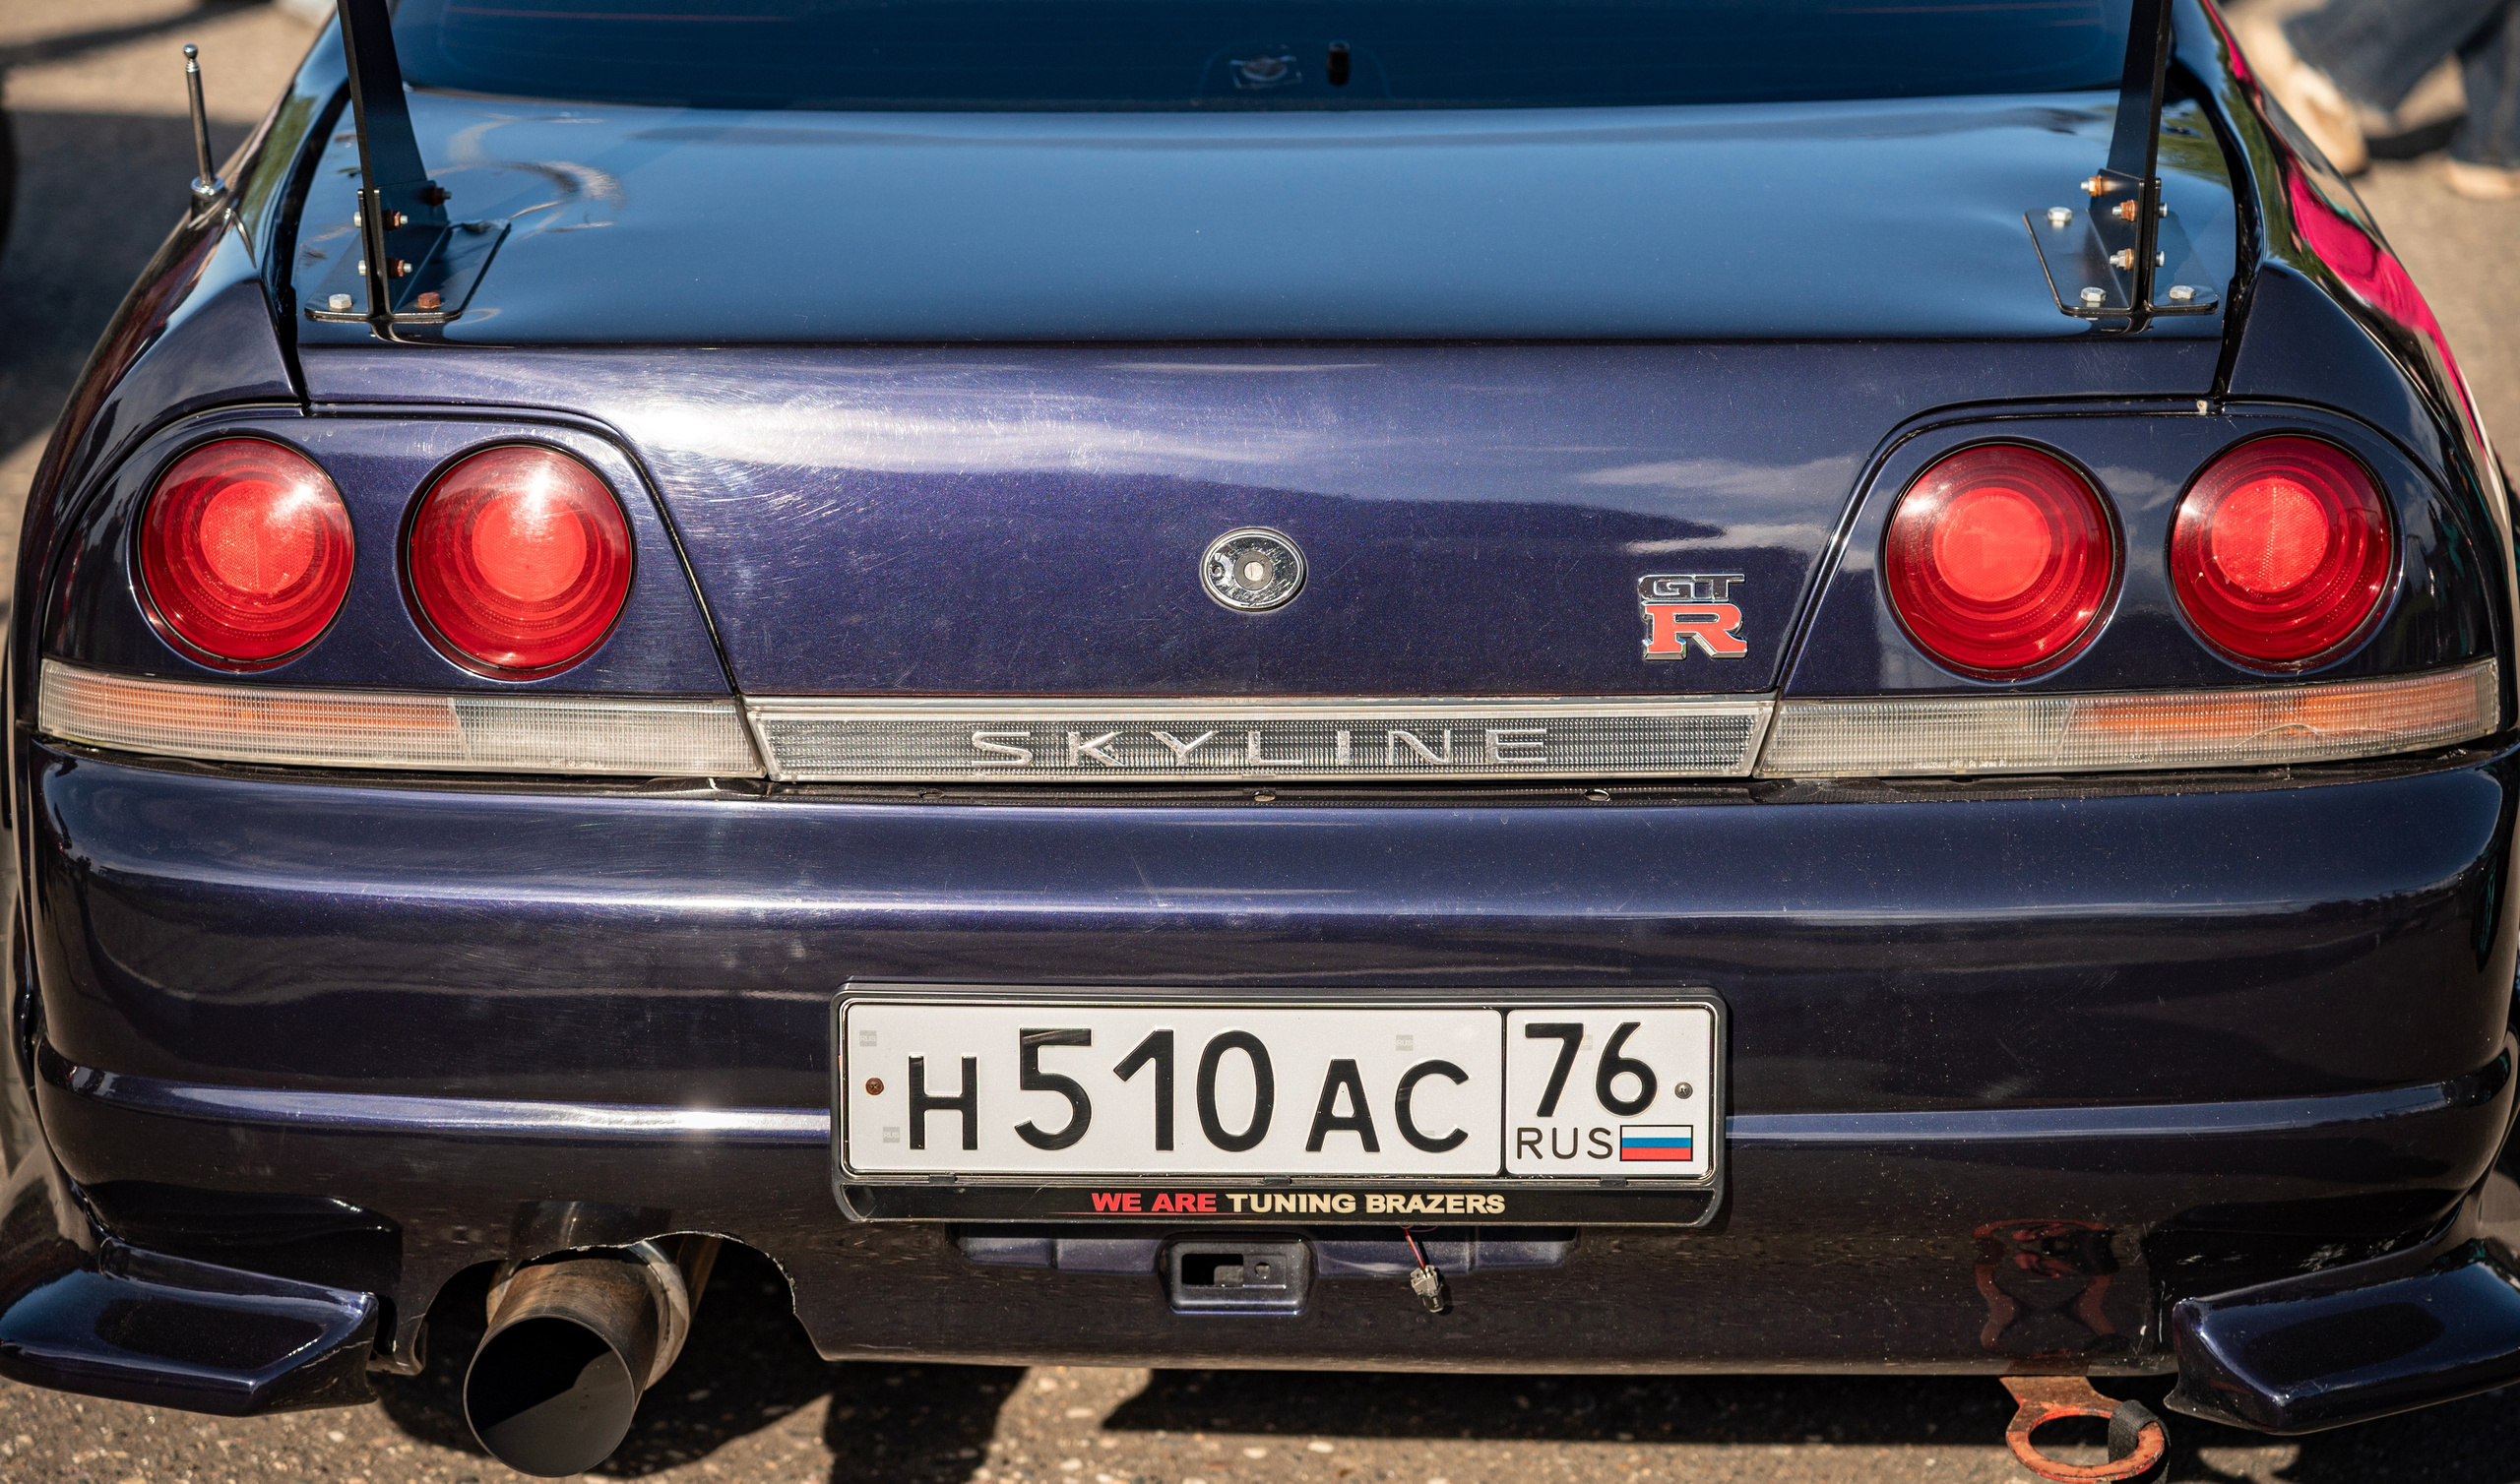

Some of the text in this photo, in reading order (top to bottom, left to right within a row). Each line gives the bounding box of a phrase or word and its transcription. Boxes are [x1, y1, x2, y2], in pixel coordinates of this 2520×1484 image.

[1638, 574, 1745, 602] GT
[1641, 600, 1748, 660] R
[971, 729, 1547, 768] SKYLINE
[1525, 1021, 1658, 1117] 76
[1517, 1127, 1613, 1159] RUS
[1091, 1193, 1506, 1214] WE ARE TUNING BRAZERS
